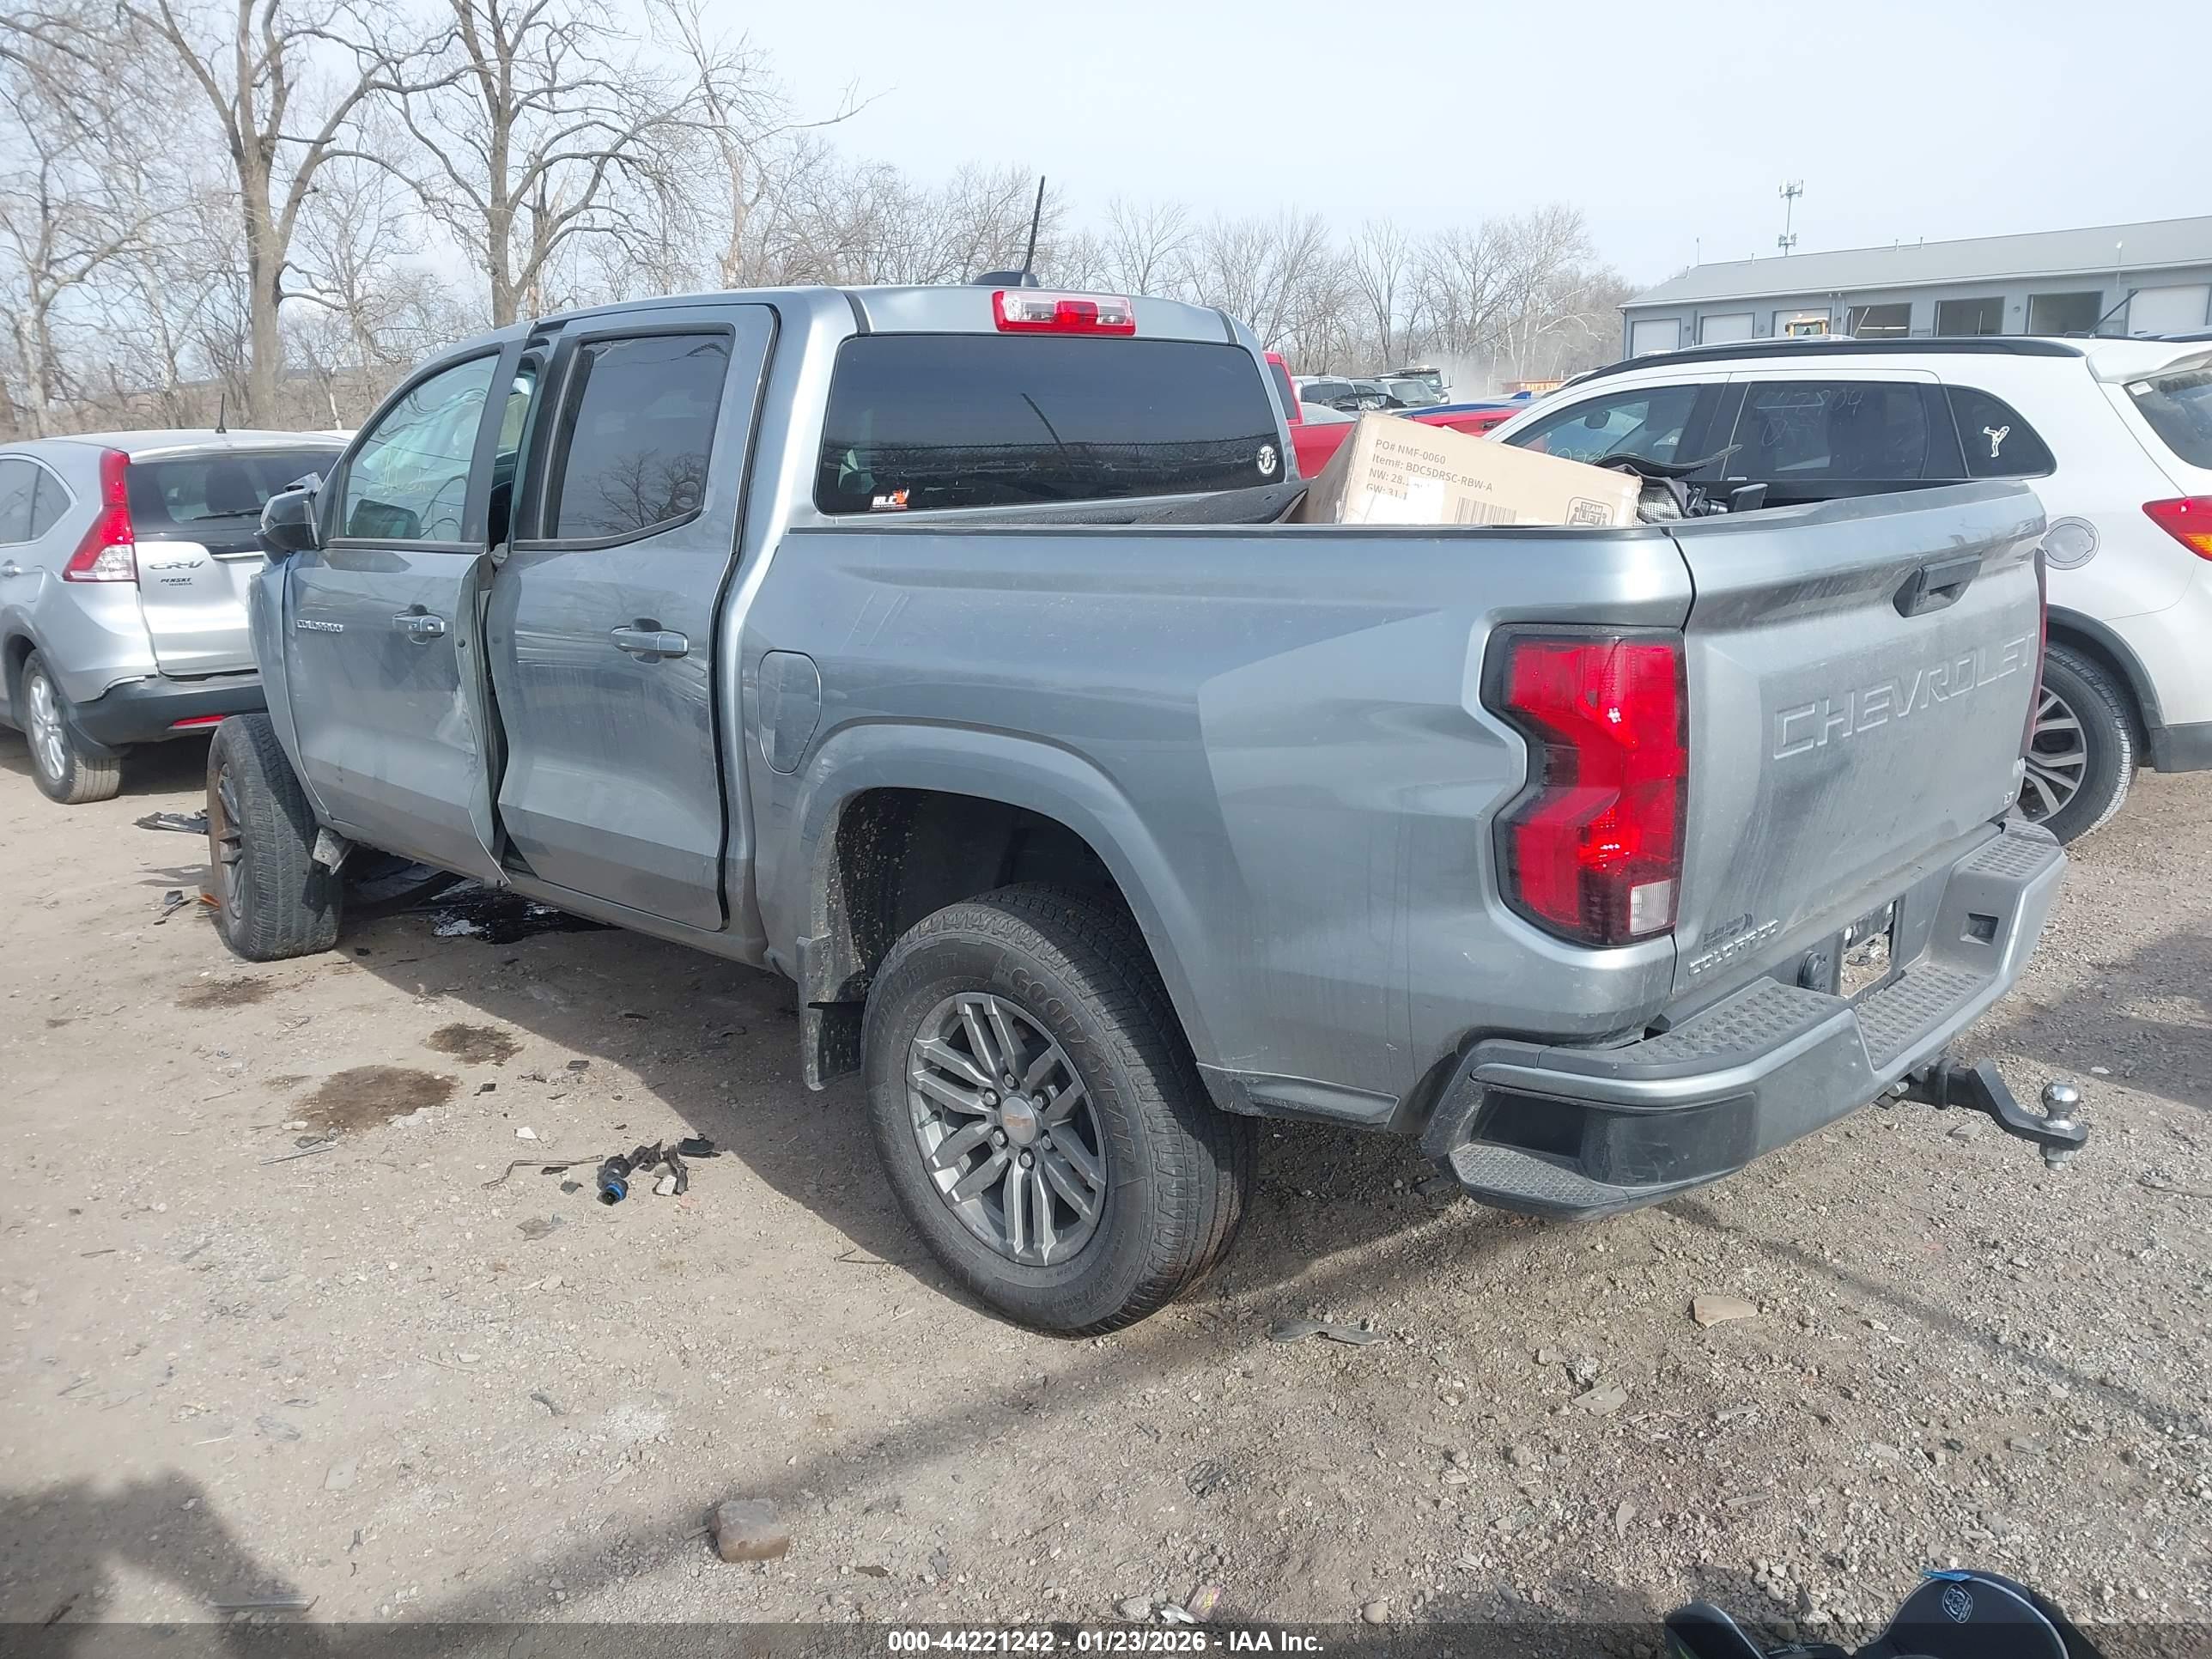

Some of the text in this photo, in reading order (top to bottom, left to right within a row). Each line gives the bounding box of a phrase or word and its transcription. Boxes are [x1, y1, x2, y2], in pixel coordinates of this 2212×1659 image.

[1376, 439, 1447, 465] PO# NMF-0060
[1369, 467, 1389, 481] NW:
[1372, 453, 1492, 492] Item#: BDC5DRSC-RBW-A
[1579, 511, 1601, 524] LIFT
[1582, 502, 1602, 514] TEAM
[1773, 630, 2036, 759] CHEVROLET
